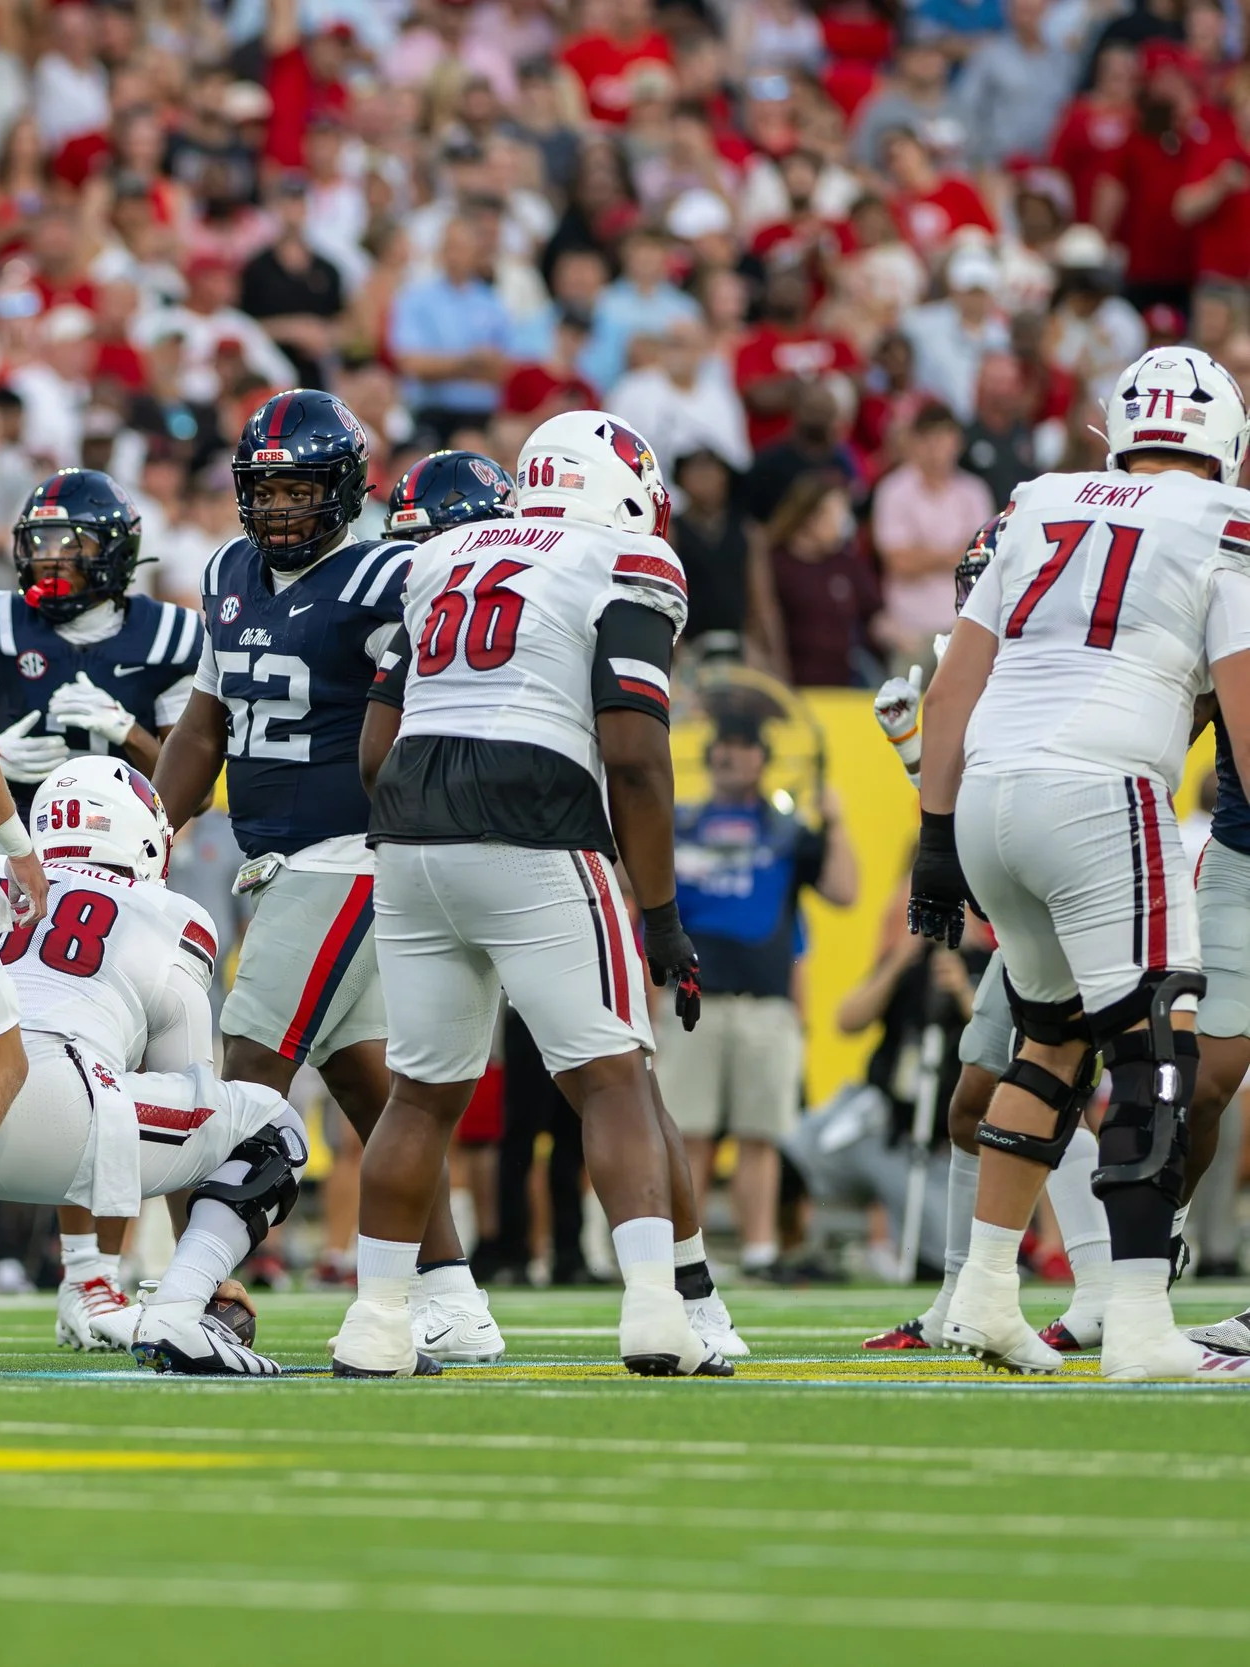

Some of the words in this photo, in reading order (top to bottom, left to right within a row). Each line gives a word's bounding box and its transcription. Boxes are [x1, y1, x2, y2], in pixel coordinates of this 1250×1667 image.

[1146, 388, 1174, 419] 71
[257, 451, 284, 461] REBS
[528, 457, 554, 488] 66
[1074, 481, 1153, 508] HENRY
[451, 531, 473, 556] J.
[468, 527, 543, 551] BROWN
[1005, 520, 1144, 651] 71
[220, 596, 240, 622] SEC
[417, 558, 534, 677] 66
[239, 627, 257, 646] Ole
[251, 628, 272, 647] Miss
[19, 651, 47, 678] SEC
[214, 650, 311, 762] 52
[51, 799, 81, 830] 58
